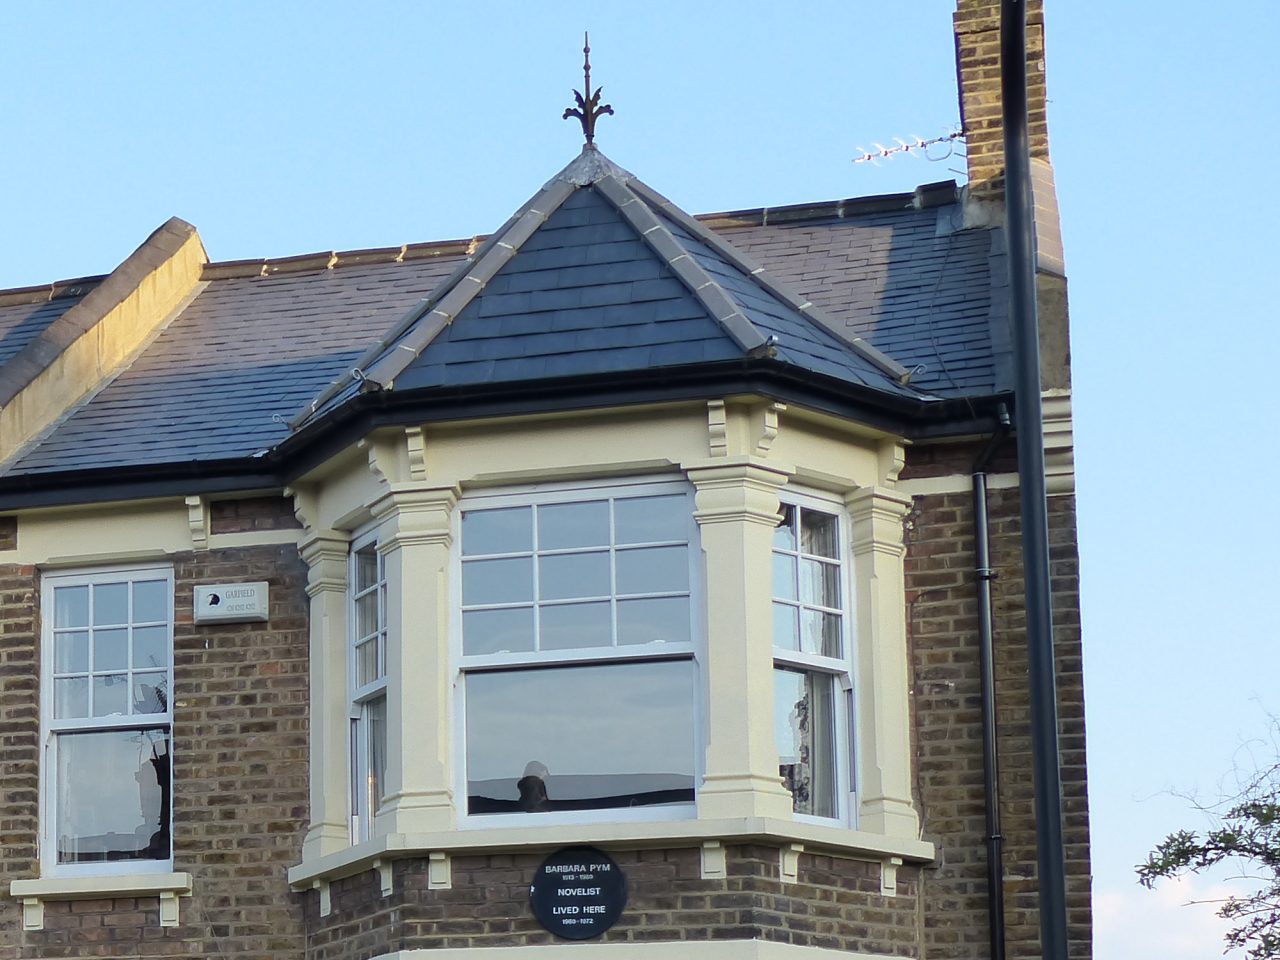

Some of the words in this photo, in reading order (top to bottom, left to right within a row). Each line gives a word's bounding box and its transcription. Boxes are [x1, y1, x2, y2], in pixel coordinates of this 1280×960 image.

[545, 864, 586, 873] BARBARA
[589, 863, 611, 872] PYM
[557, 887, 601, 896] NOVELIST
[552, 906, 580, 915] LIVED
[582, 905, 606, 914] HERE
